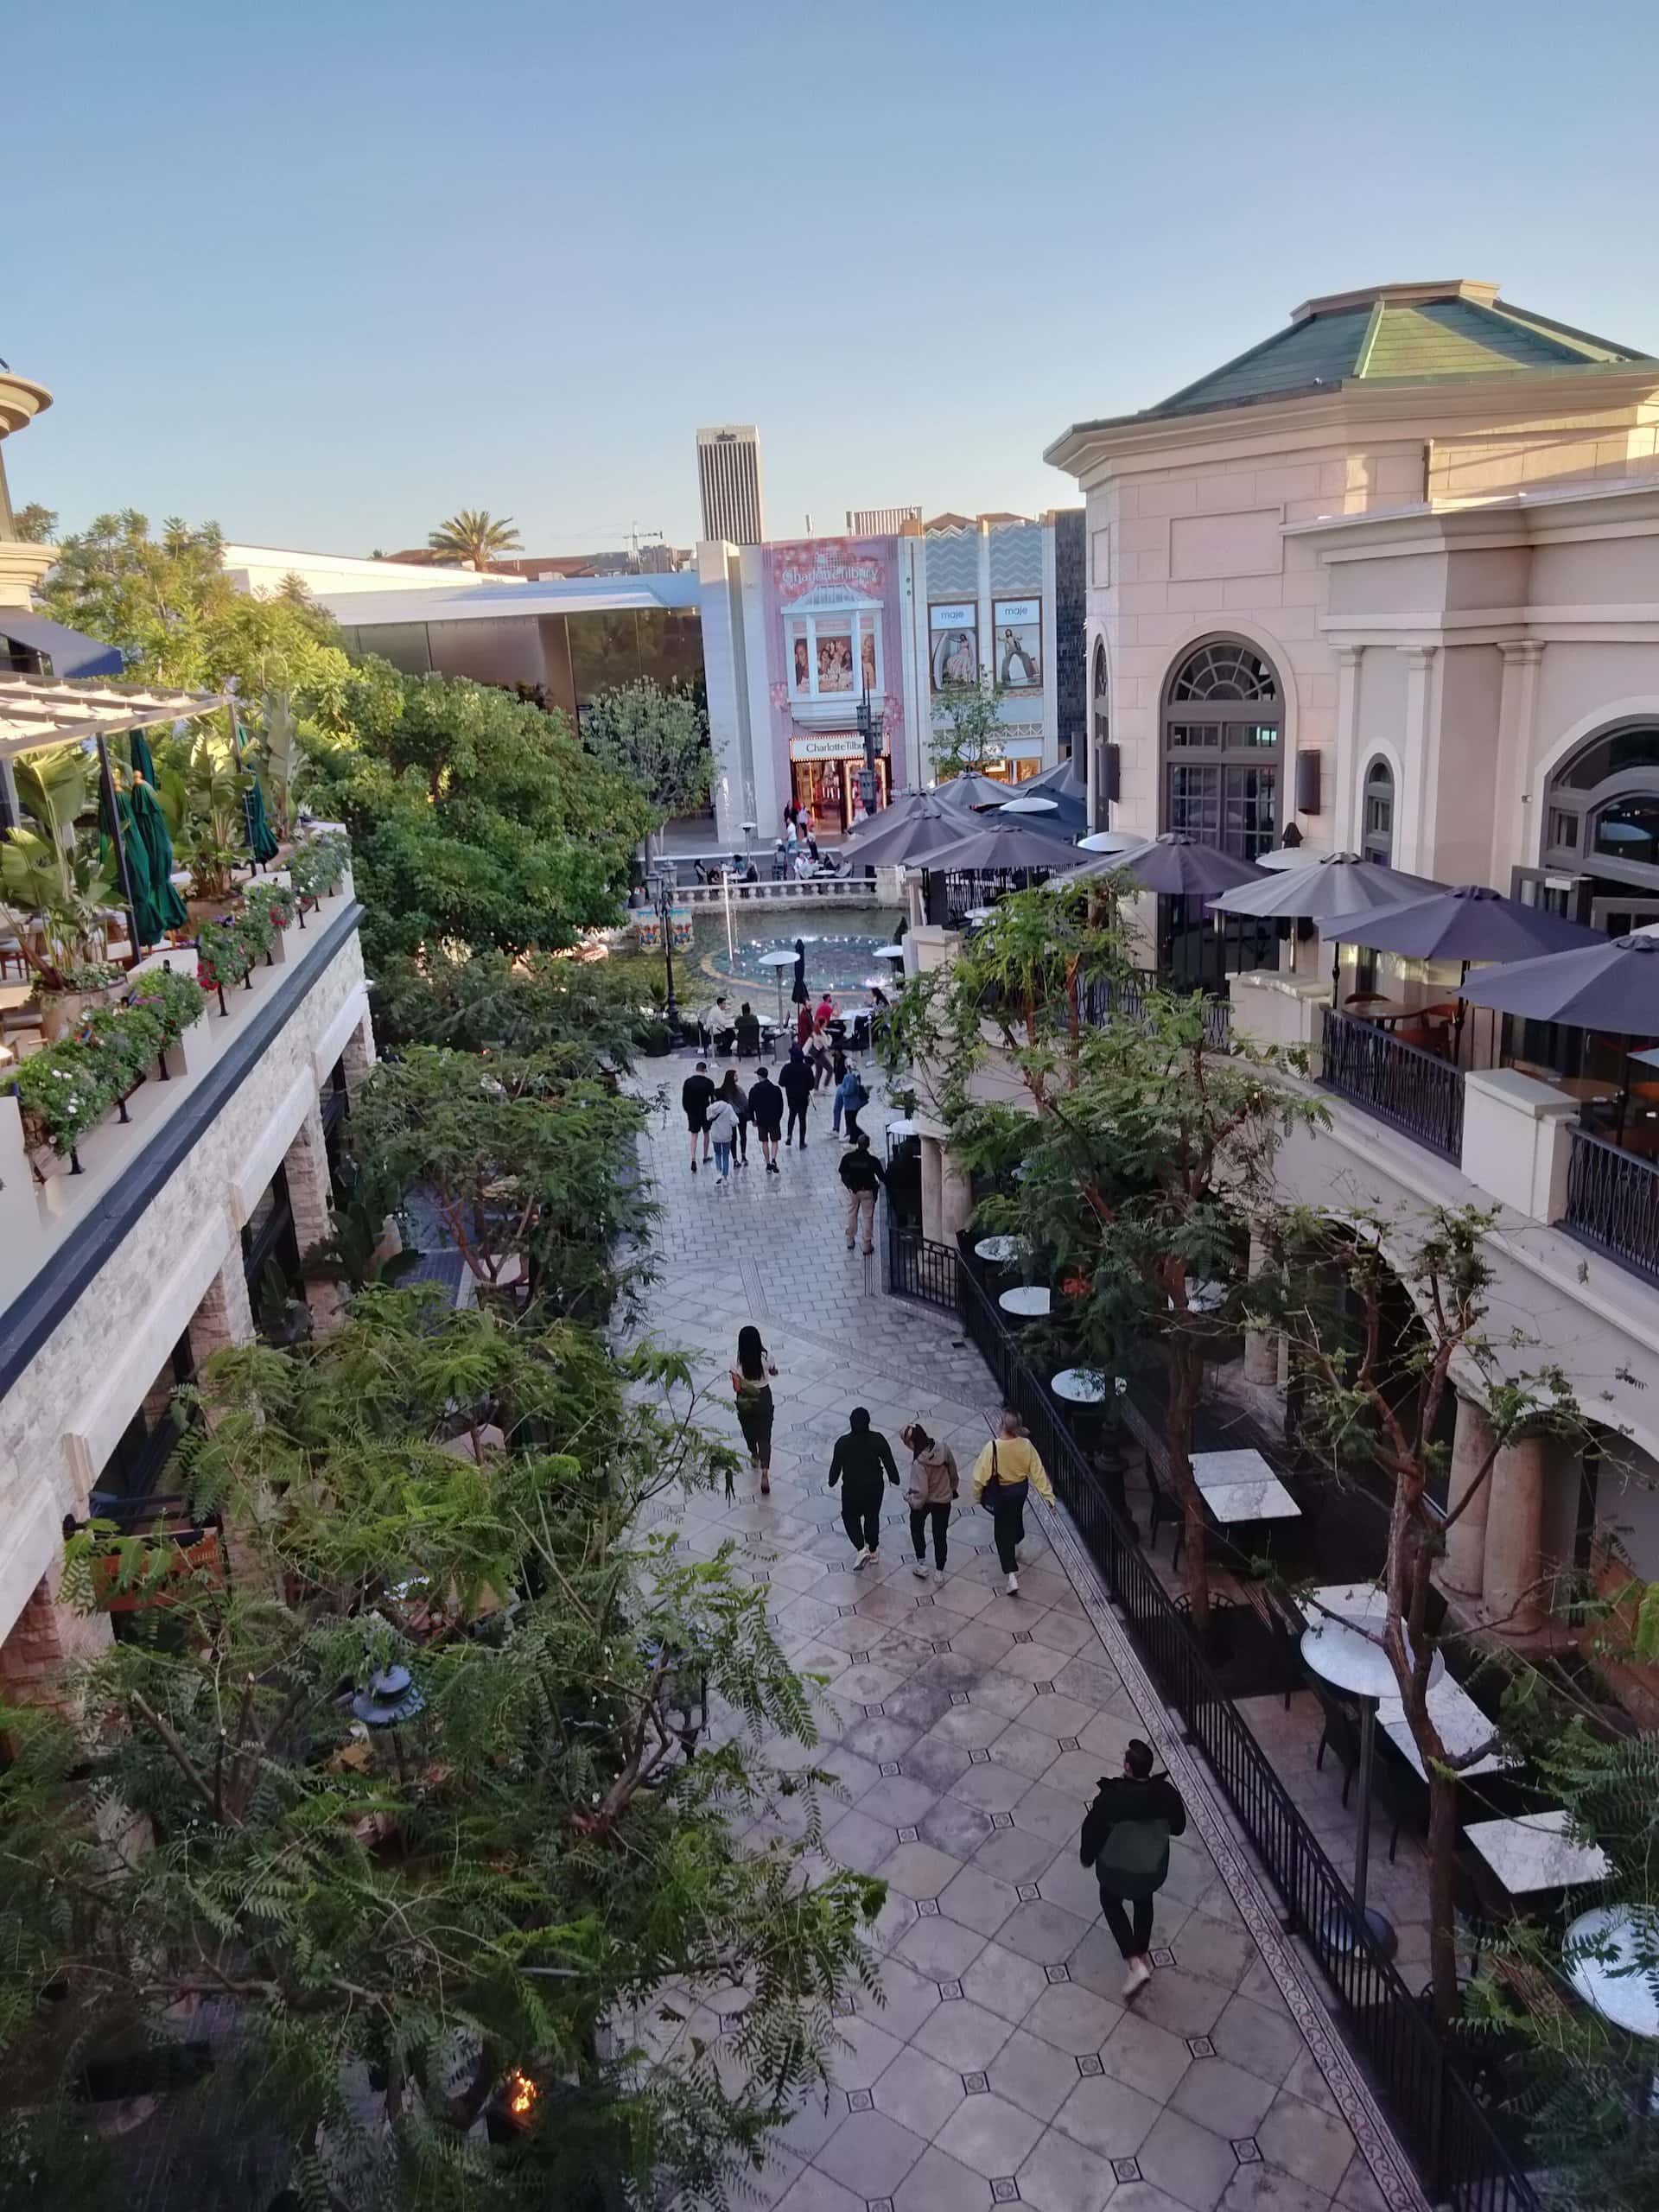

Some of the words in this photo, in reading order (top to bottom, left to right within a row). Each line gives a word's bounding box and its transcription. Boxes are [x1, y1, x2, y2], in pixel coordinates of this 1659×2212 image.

[940, 610, 964, 620] maje
[1004, 606, 1028, 616] maje
[806, 742, 845, 753] Charlotte
